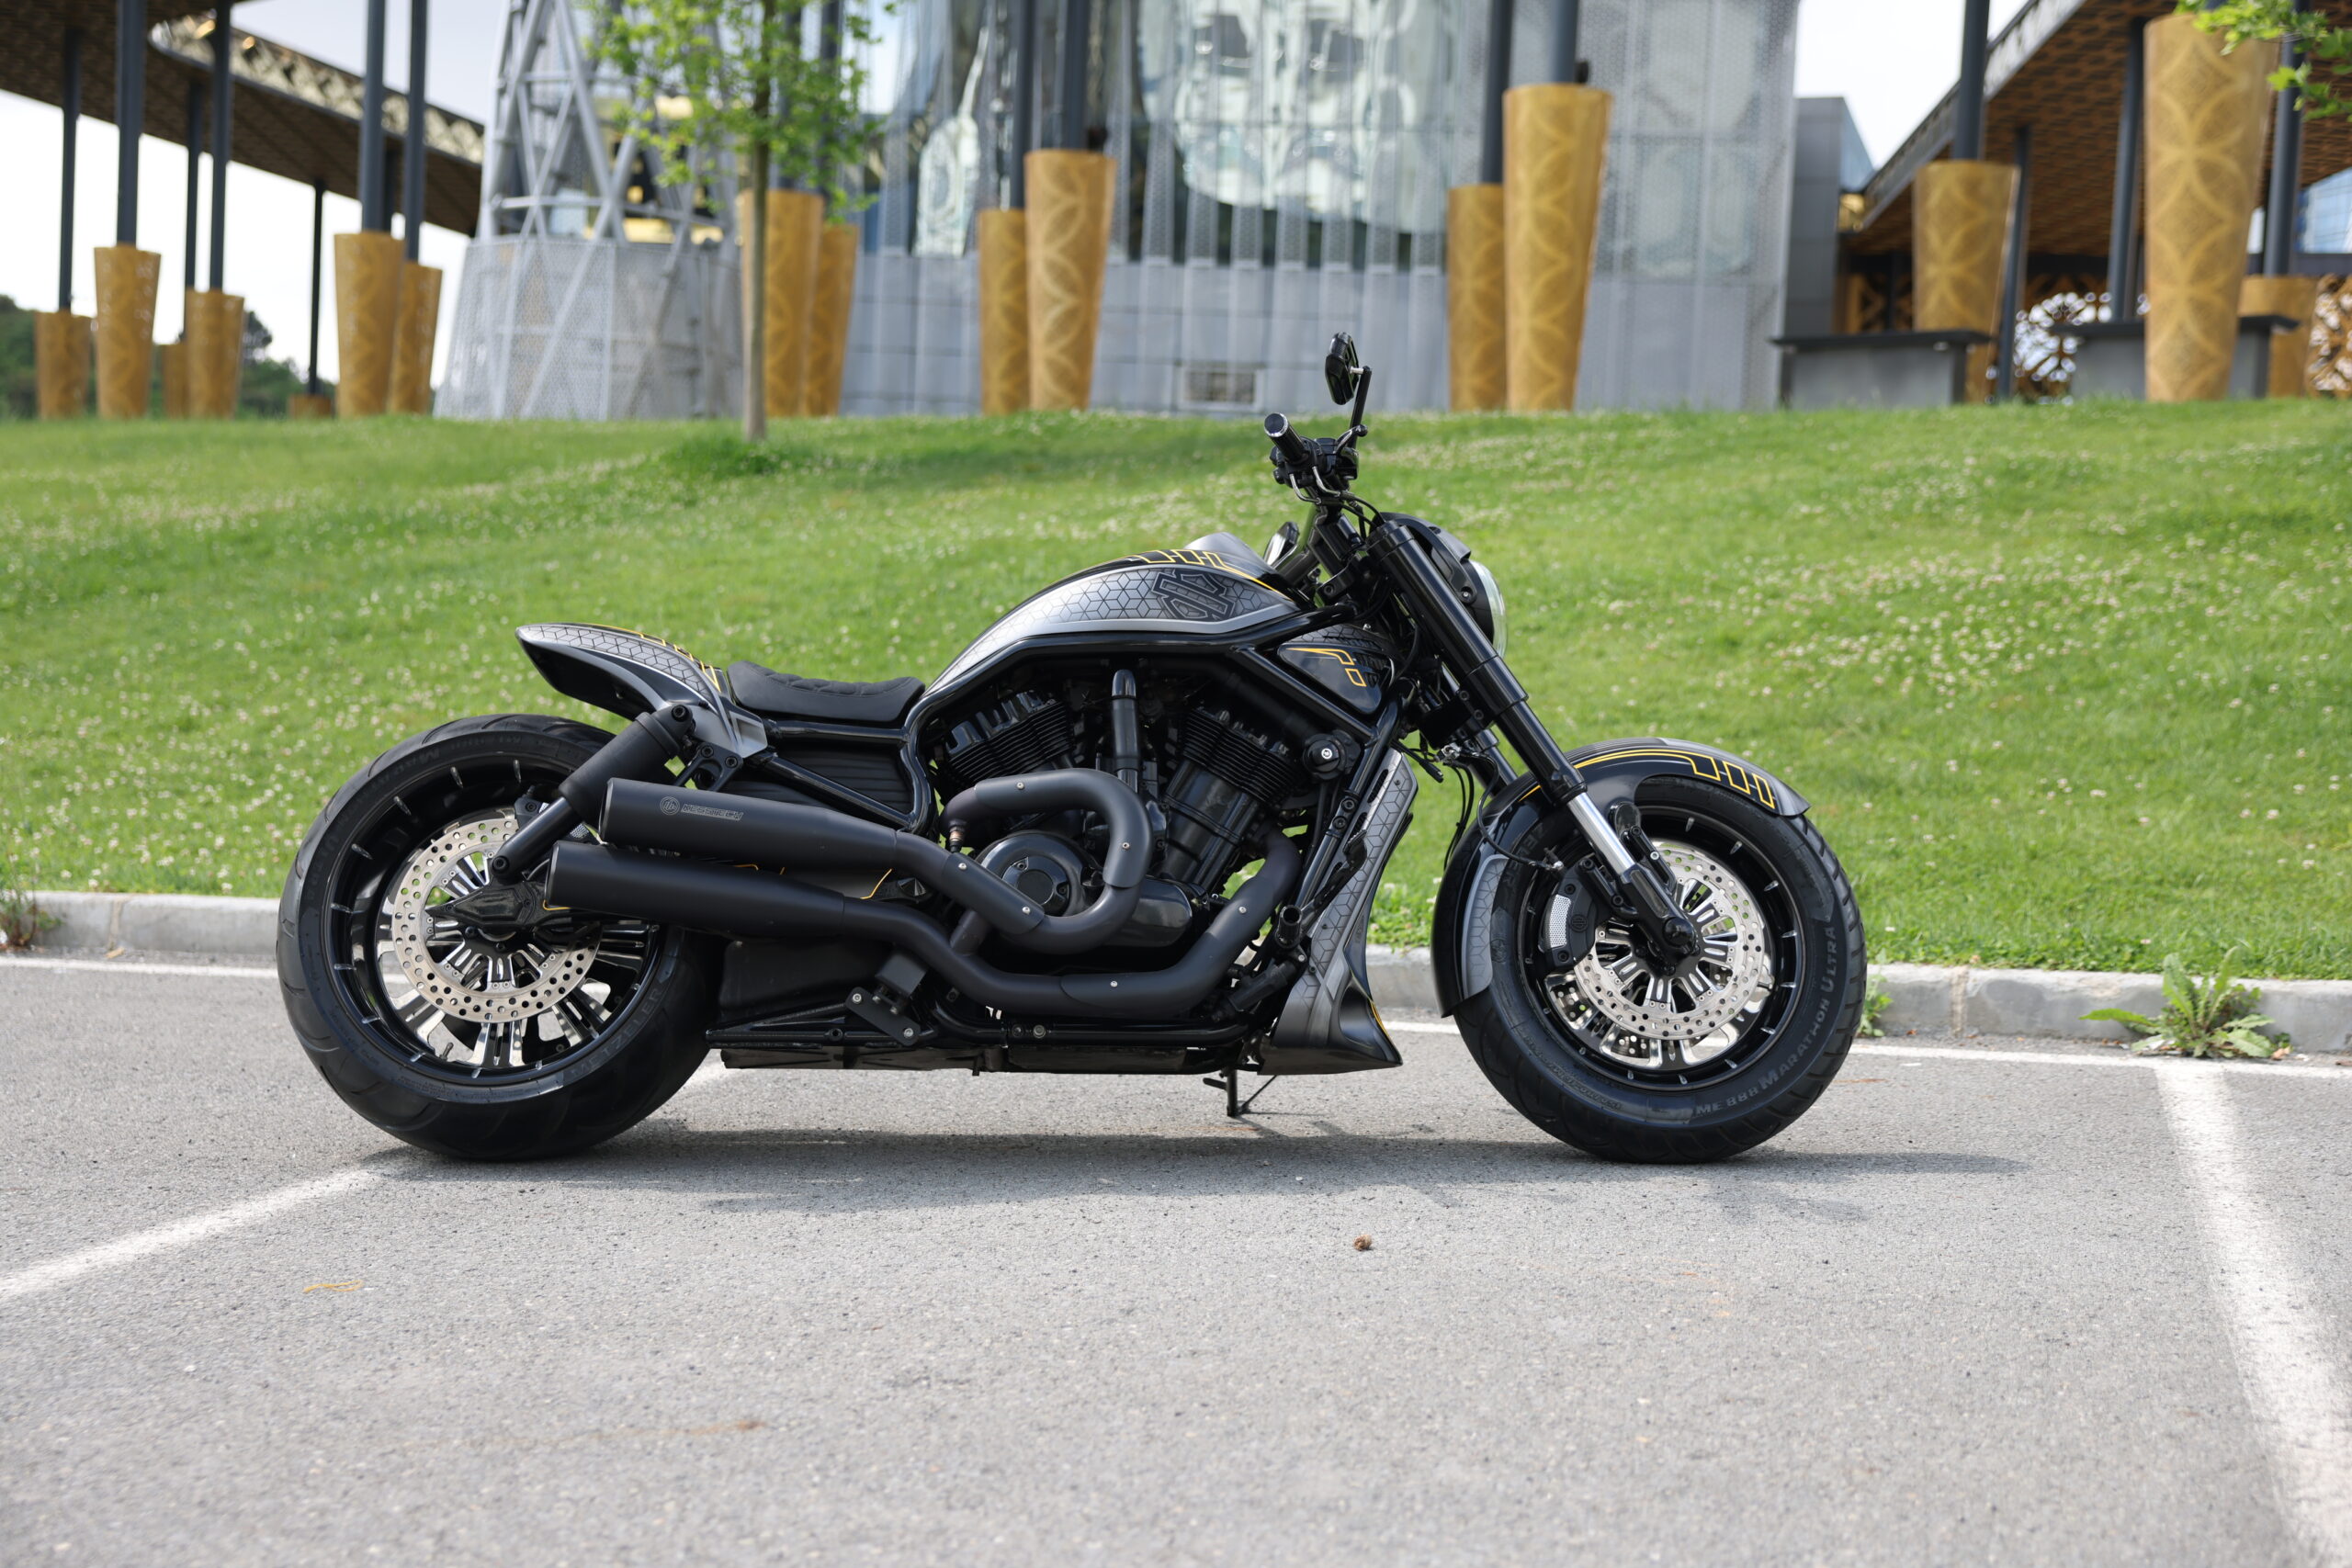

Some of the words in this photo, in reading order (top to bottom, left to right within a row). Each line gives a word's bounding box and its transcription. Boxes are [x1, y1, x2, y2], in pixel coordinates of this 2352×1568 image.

[570, 987, 662, 1077] METZELER
[1696, 1102, 1724, 1115] ME
[1726, 1087, 1758, 1107] 888
[1758, 998, 1831, 1090] MARATHON
[1821, 925, 1838, 993] ULTRA
